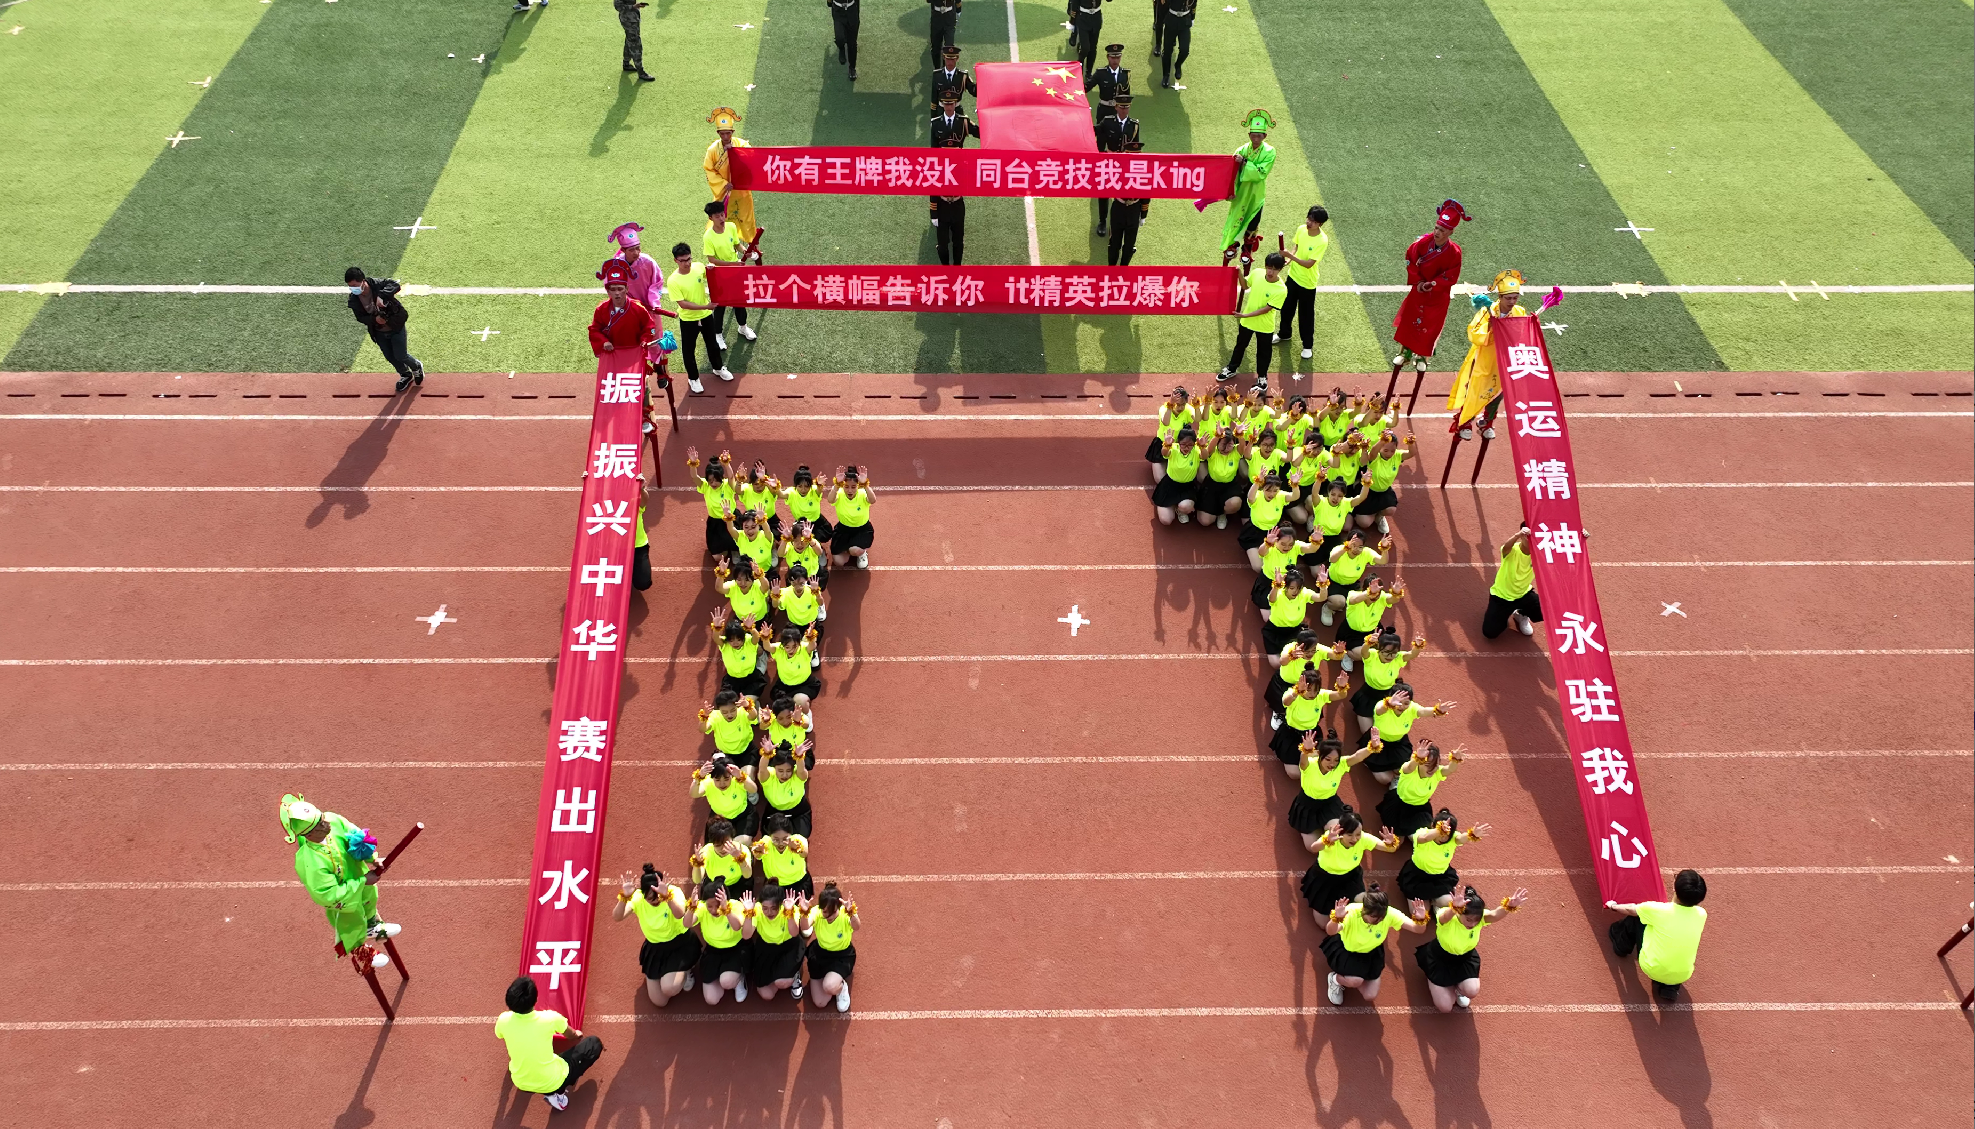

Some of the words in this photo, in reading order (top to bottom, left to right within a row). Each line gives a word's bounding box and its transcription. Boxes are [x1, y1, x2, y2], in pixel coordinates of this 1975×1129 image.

[763, 155, 958, 189] 你有王牌我没k
[976, 157, 1205, 192] 同台竞技我是king
[743, 274, 985, 307] 拉个横幅告诉你
[1005, 275, 1200, 308] it精英拉爆你
[1507, 343, 1582, 564] 奥运精神
[1555, 611, 1649, 869] 永驻我心
[529, 716, 608, 990] 赛出水平
